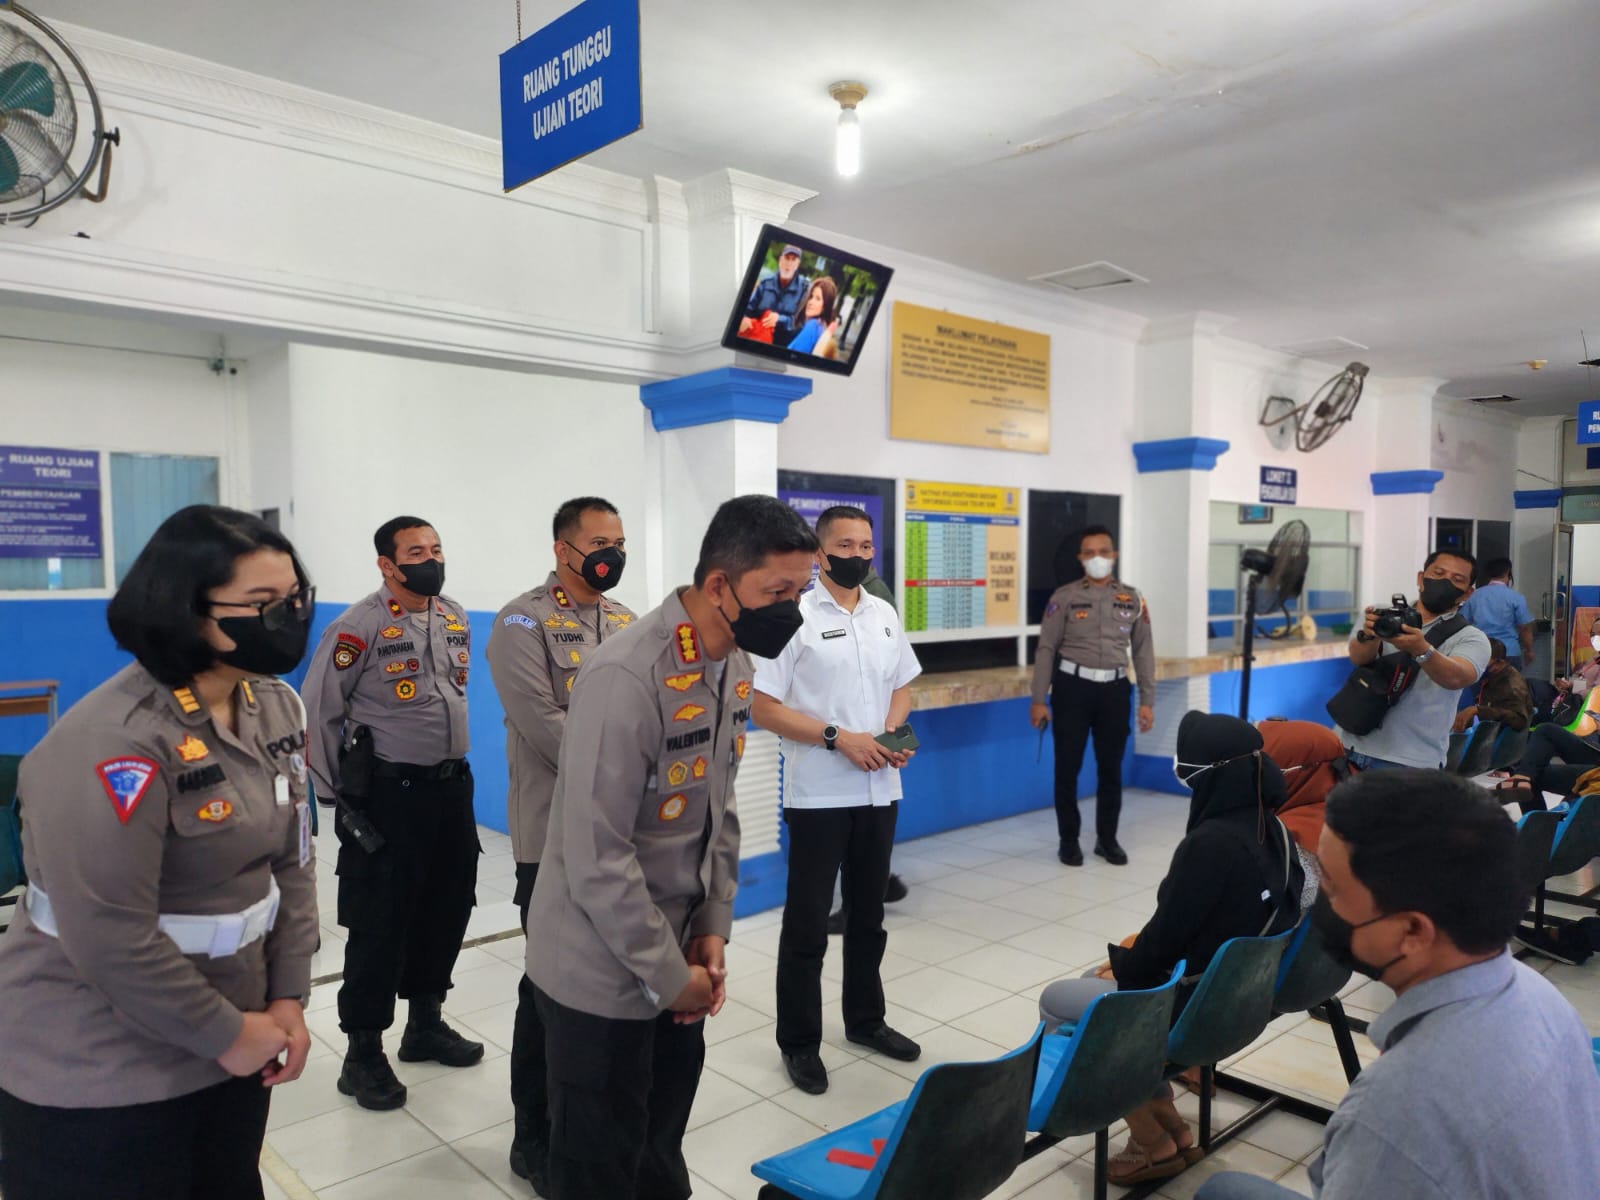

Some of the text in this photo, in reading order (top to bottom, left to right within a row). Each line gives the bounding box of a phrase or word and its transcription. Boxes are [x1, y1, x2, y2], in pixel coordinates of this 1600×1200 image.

[522, 25, 612, 104] RUANG TUNGGU
[532, 76, 603, 140] UJIAN TEORI
[9, 453, 94, 469] RUANG UJIAN
[34, 466, 72, 478] TEORI
[552, 633, 585, 643] YUDHI
[666, 727, 711, 753] VALENTINO
